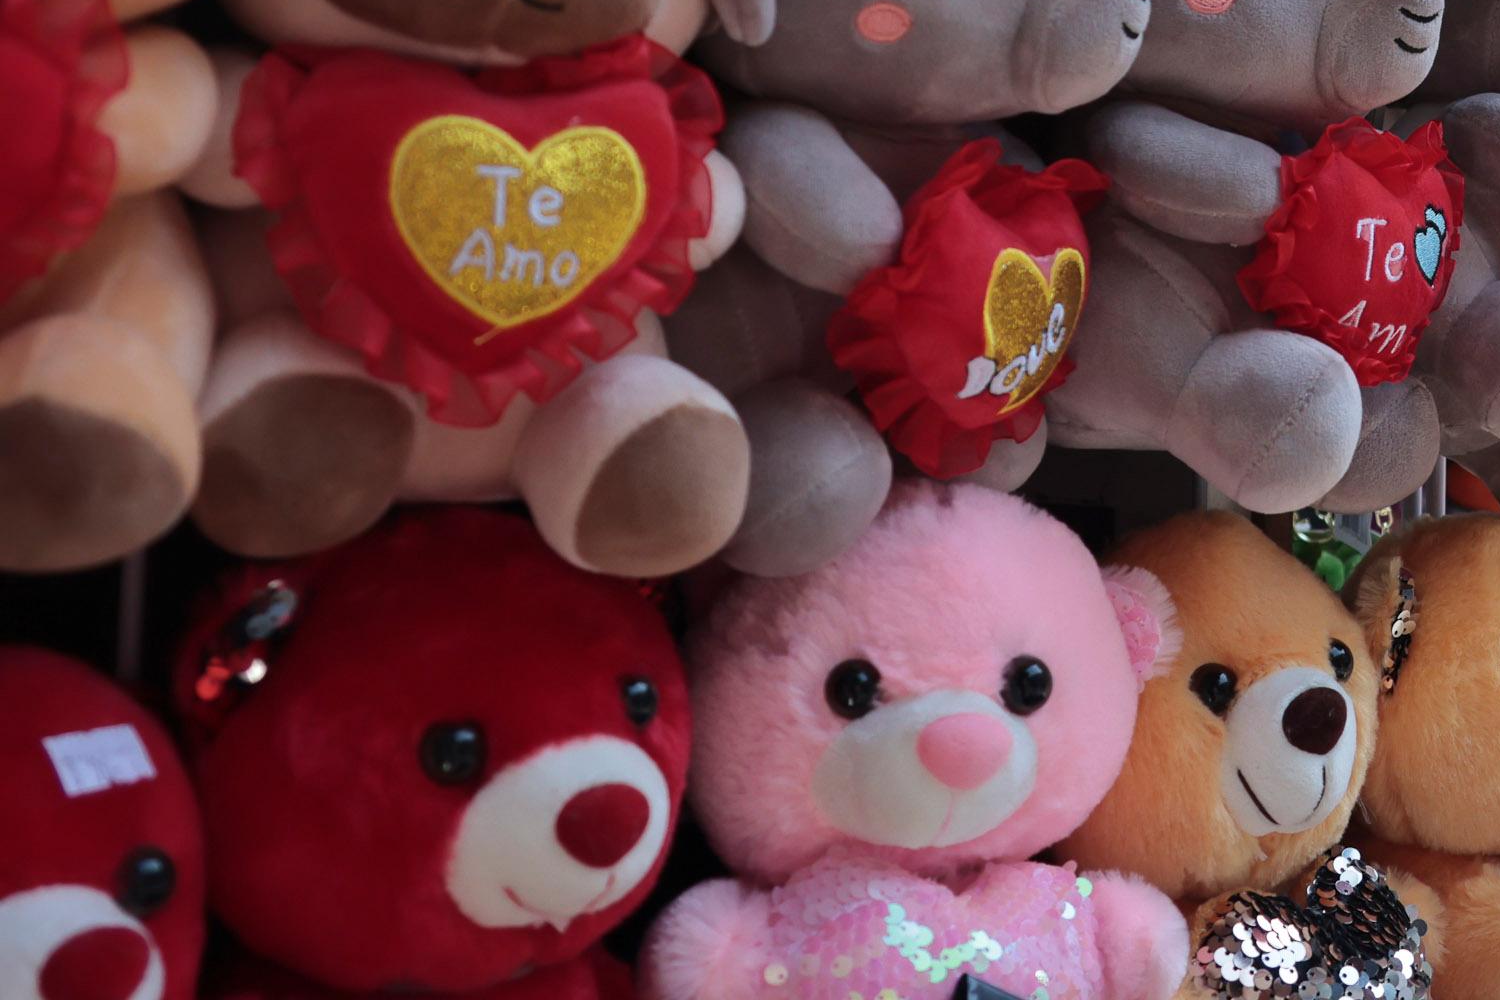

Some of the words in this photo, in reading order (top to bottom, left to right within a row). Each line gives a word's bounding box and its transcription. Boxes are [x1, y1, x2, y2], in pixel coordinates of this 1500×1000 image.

[476, 164, 564, 228] Te
[449, 226, 581, 288] Amo
[1356, 217, 1405, 282] Te
[1338, 300, 1407, 354] Am
